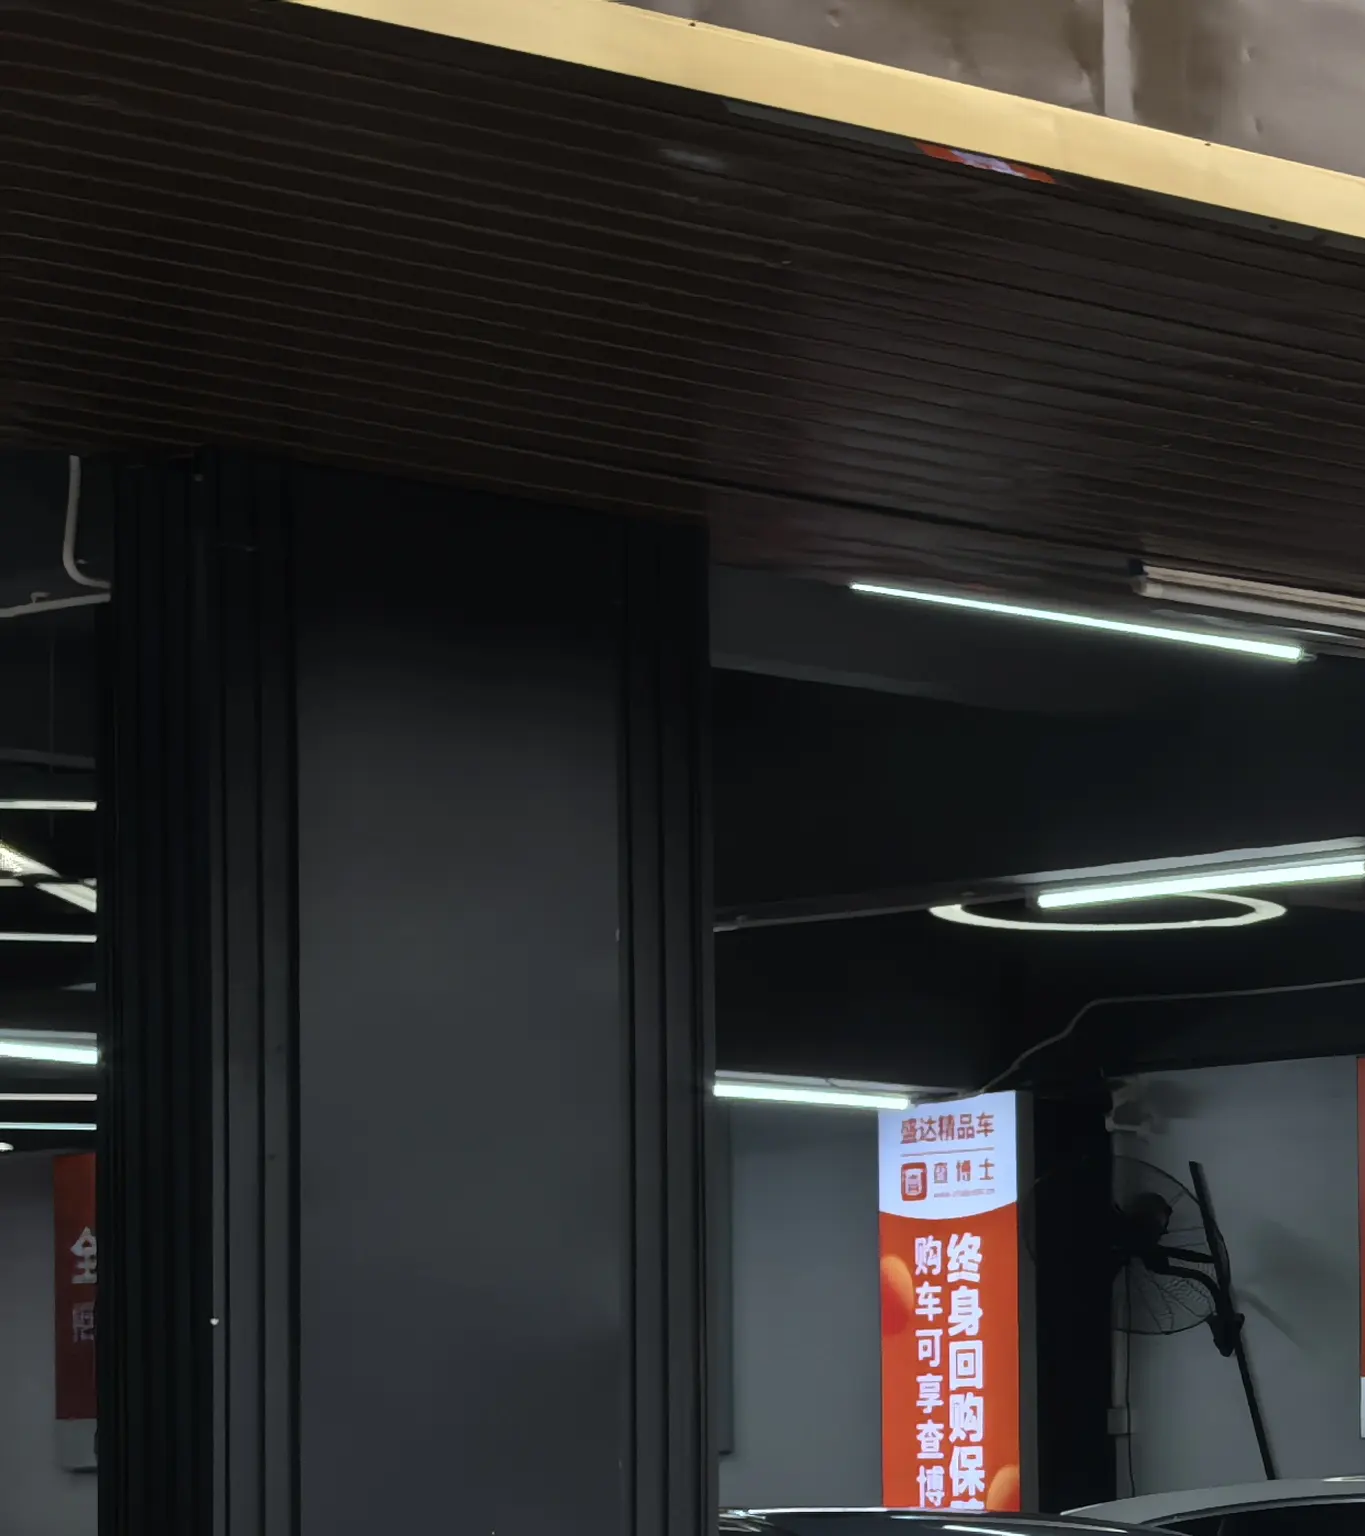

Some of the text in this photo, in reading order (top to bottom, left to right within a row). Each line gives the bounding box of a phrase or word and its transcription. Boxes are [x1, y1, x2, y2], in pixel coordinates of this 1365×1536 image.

[900, 1111, 994, 1144] 盛达精品车
[946, 1231, 986, 1509] 终身回购保
